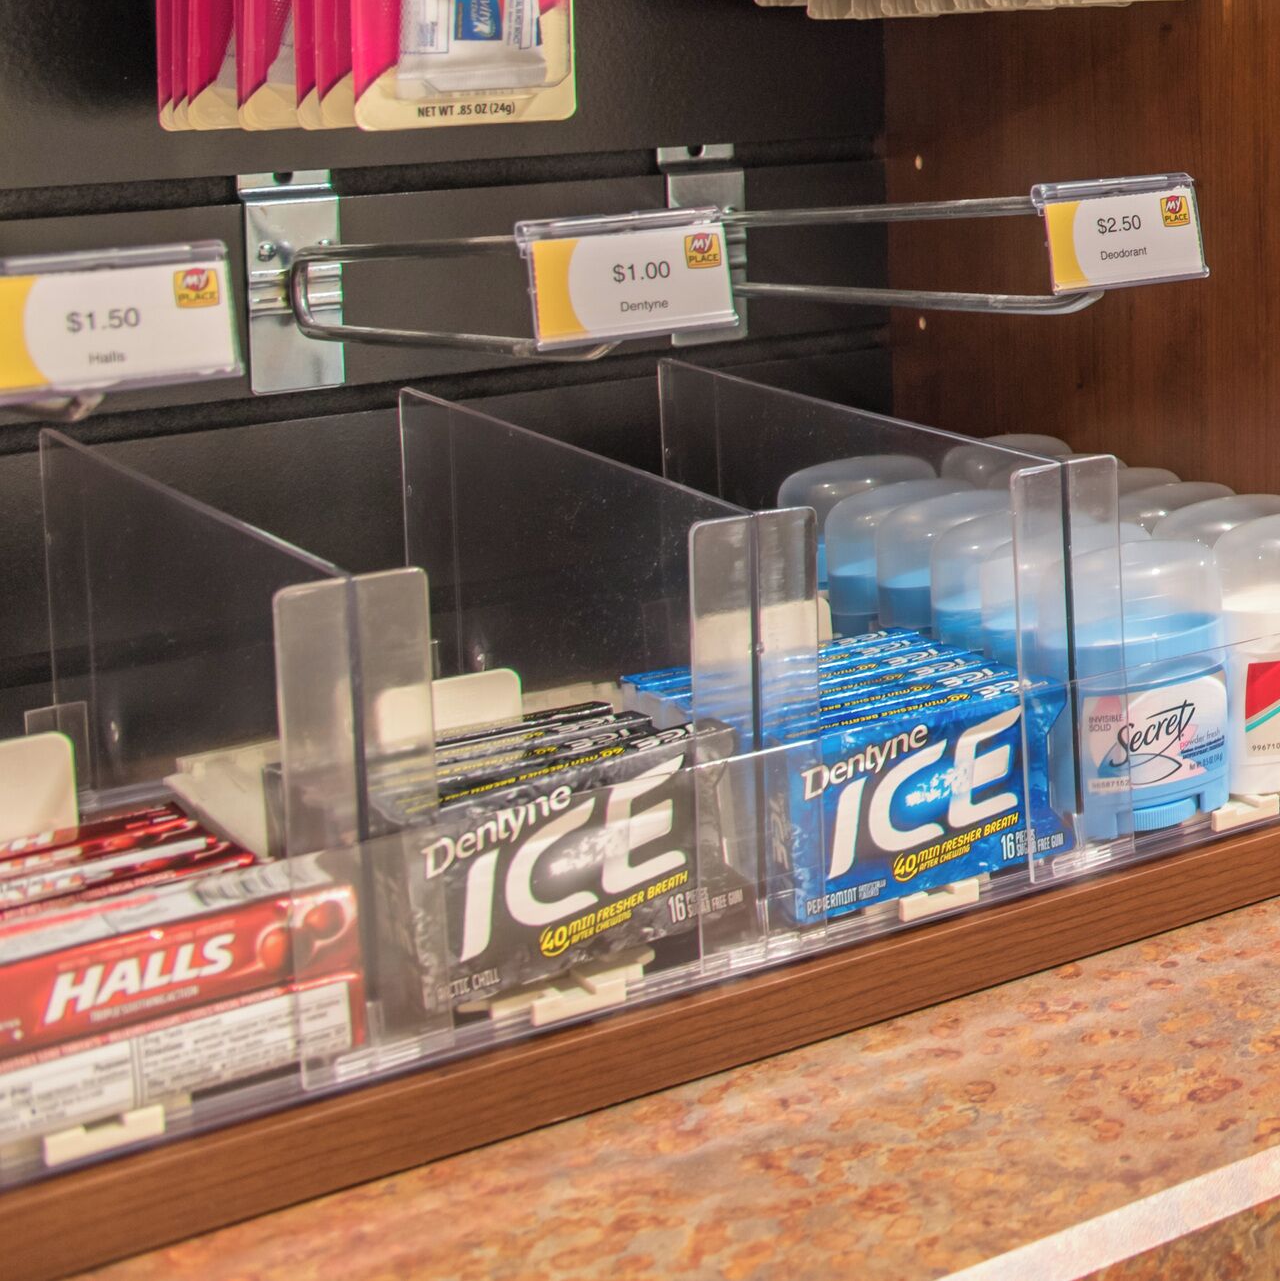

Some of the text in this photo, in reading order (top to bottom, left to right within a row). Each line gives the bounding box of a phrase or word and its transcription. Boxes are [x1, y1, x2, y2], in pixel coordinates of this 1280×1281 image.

[418, 101, 516, 118] NET WT .85 OZ (24g)
[1097, 214, 1141, 235] $2.50
[1164, 213, 1189, 223] PLACE
[688, 250, 721, 266] PLACE
[1100, 246, 1147, 261] Deodorant
[611, 260, 672, 284] $1.00
[619, 296, 670, 314] Dentyne
[65, 307, 142, 333] $1.50
[1088, 713, 1124, 724] INVISIBLE
[1088, 723, 1112, 733] SOLID
[1108, 699, 1196, 768] Secret
[1180, 727, 1220, 751] powder fresh
[801, 723, 929, 802] Dentyne
[827, 705, 1023, 880] ICE
[421, 786, 573, 880] Dentyne
[894, 812, 1019, 878] 40 MIN FRESHER BREATH
[1000, 832, 1016, 860] 16
[459, 754, 687, 963] ICE
[918, 845, 971, 872] AFTER CHEWING
[540, 870, 689, 957] 40 MIN FRESHER BREATH
[667, 892, 685, 923] 16
[807, 889, 859, 917] PEPPERMINT
[570, 910, 632, 945] AFTER CHEWING
[44, 933, 235, 1024] HALLS
